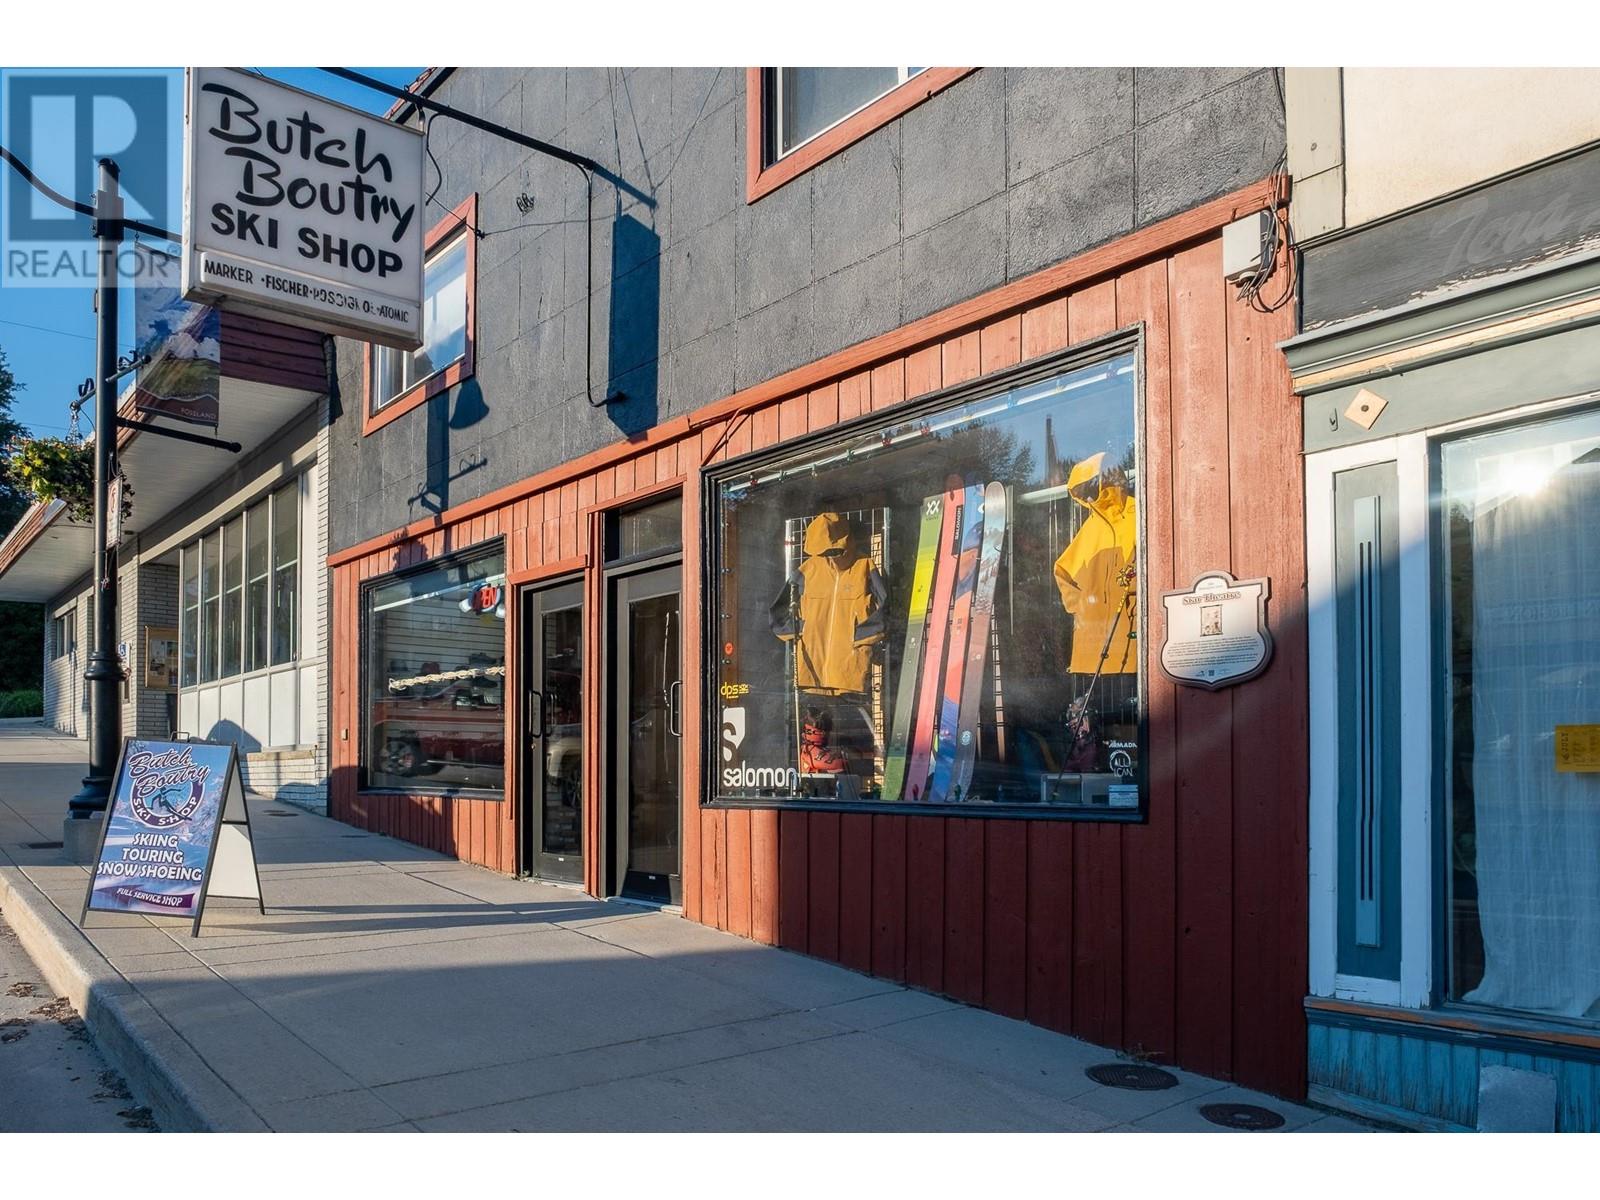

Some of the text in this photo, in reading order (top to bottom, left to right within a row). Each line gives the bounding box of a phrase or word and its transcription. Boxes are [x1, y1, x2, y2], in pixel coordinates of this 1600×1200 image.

[202, 82, 392, 182] Butch
[224, 146, 415, 243] Boutry
[211, 202, 403, 279] SKI SHOP
[204, 259, 253, 284] MARKER
[128, 746, 193, 778] Butch
[723, 760, 797, 787] salomon
[136, 764, 211, 797] Boutry
[133, 832, 179, 848] SKIING
[122, 848, 184, 864] TOURING
[97, 861, 203, 881] SNOW SHOEING
[116, 887, 183, 906] FULL SERVICE SHOP
